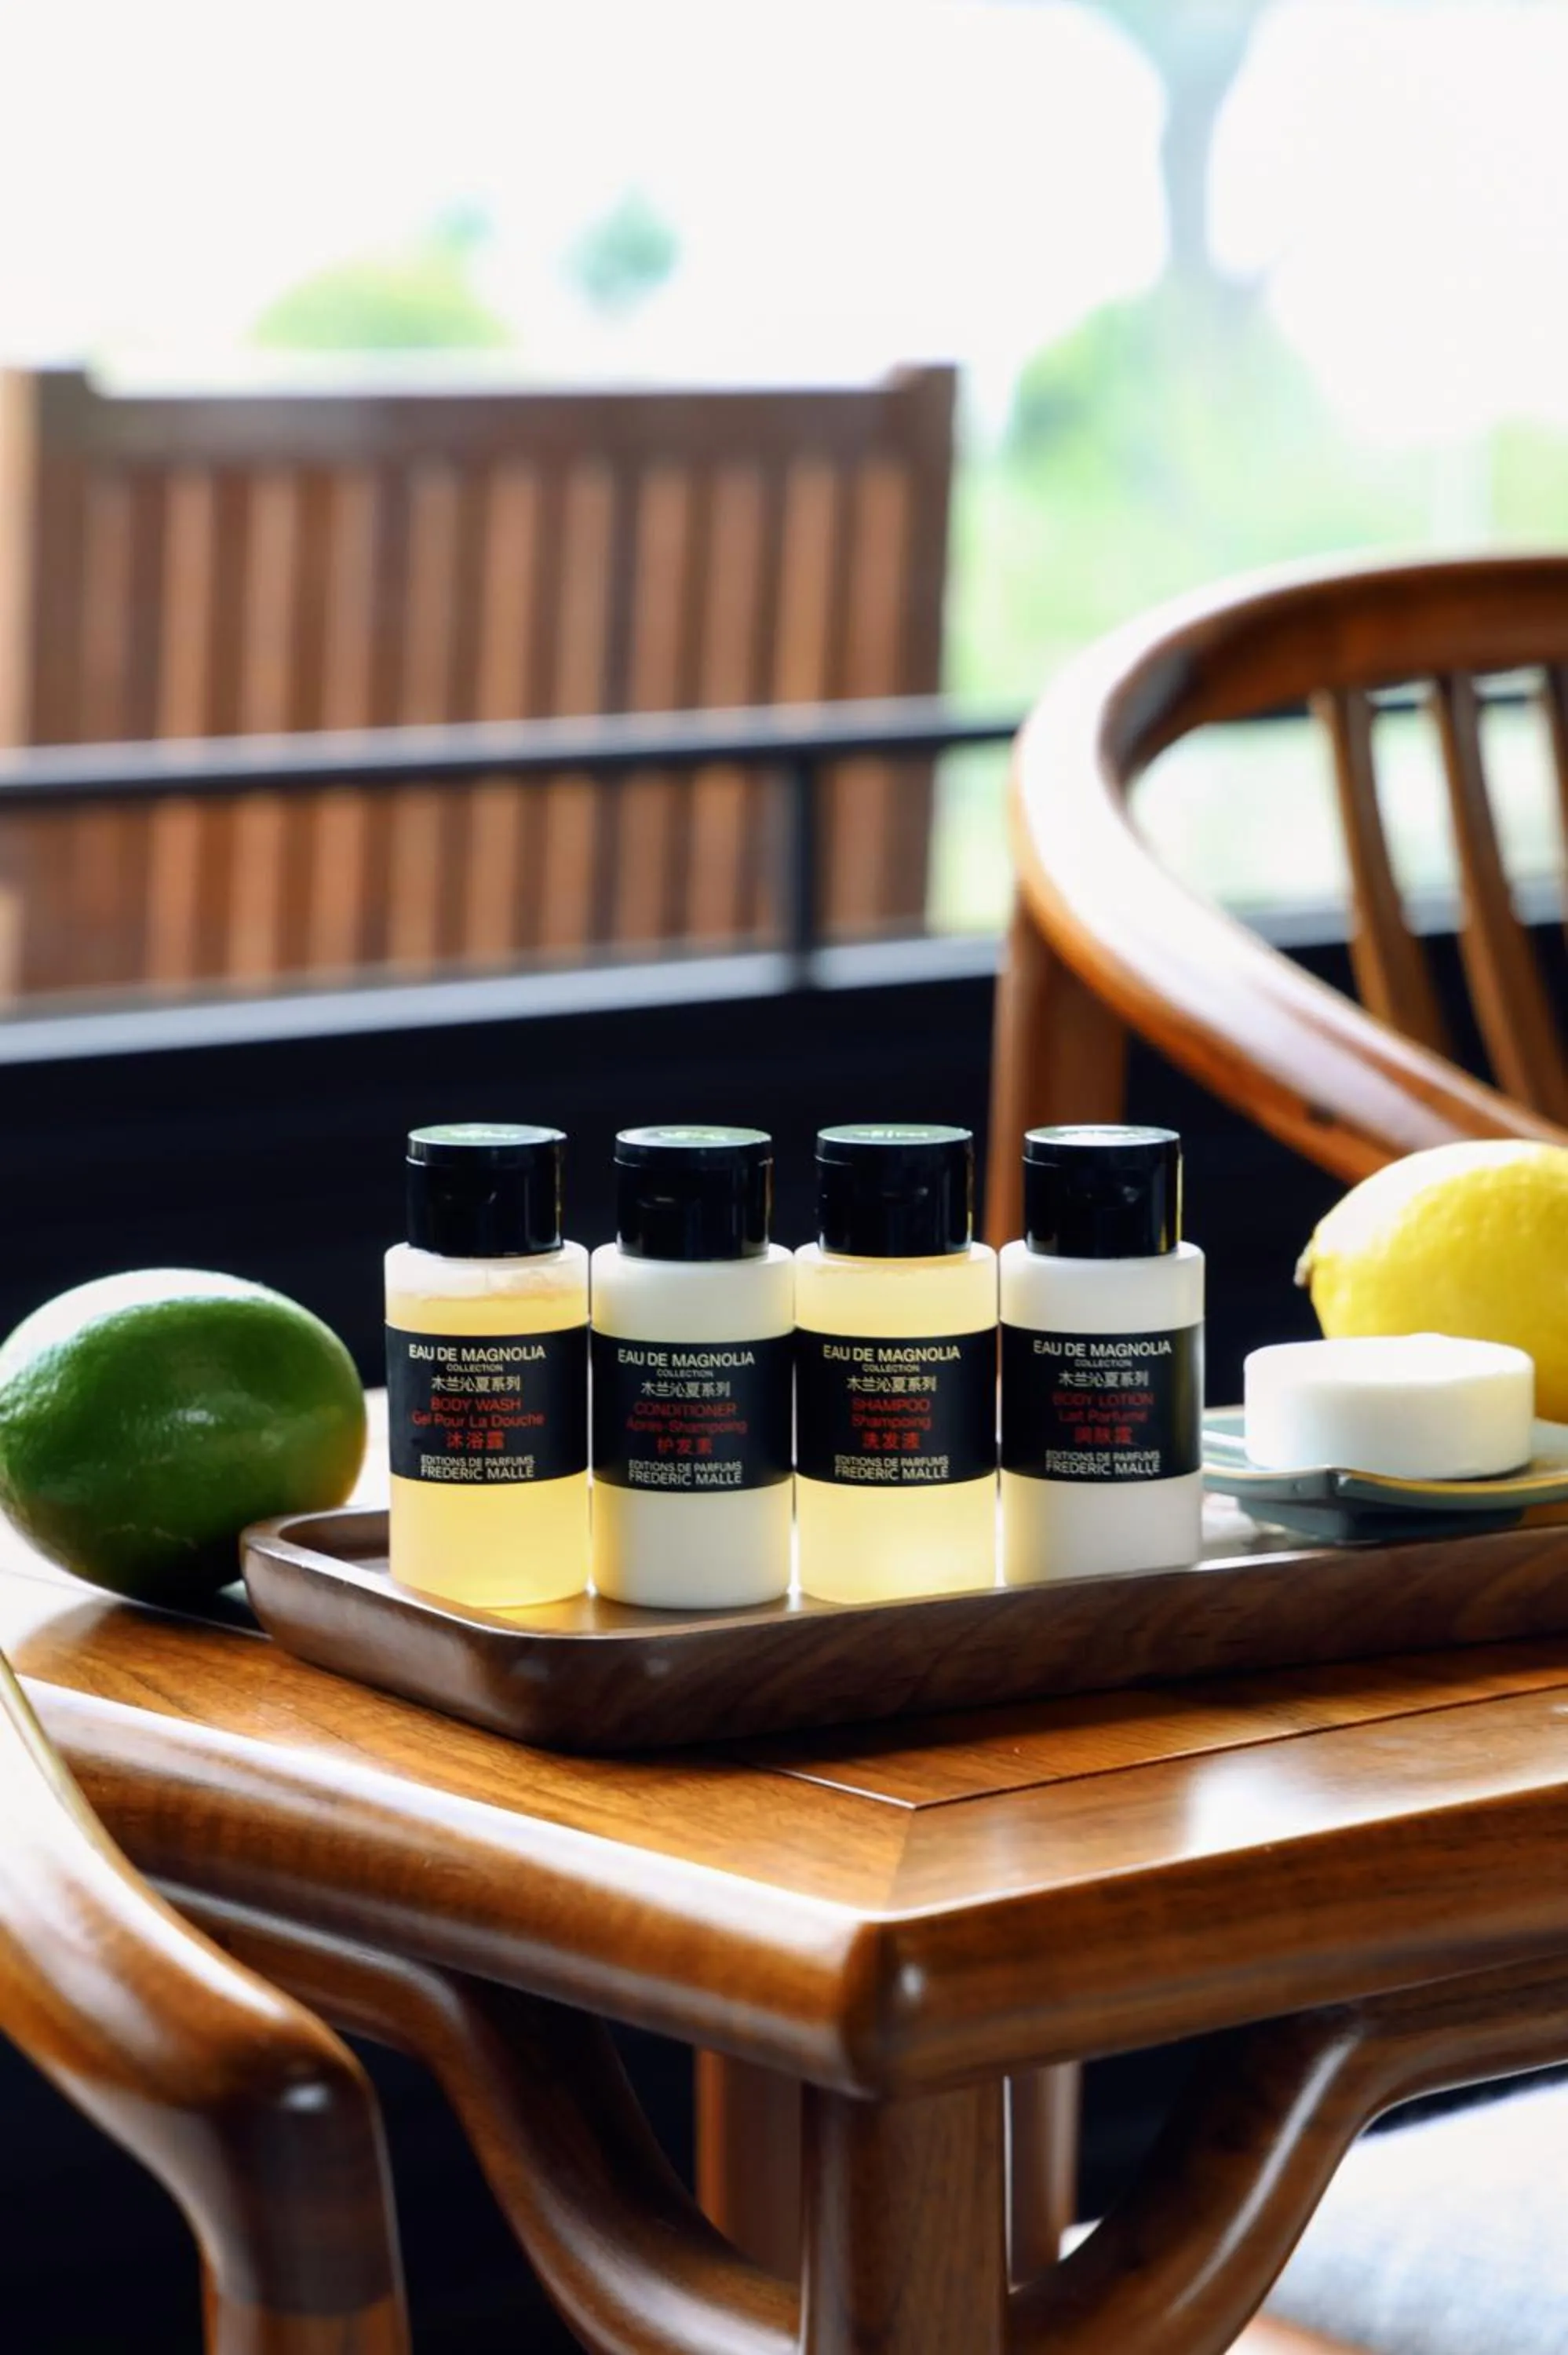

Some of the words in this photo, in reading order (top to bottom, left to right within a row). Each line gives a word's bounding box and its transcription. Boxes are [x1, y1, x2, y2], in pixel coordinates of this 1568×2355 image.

[409, 1344, 435, 1360] EAU
[437, 1348, 457, 1361] DE
[461, 1345, 545, 1361] MAGNOLIA
[823, 1345, 850, 1360] EAU
[853, 1348, 874, 1361] DE
[877, 1346, 961, 1362] MAGNOLIA
[1034, 1340, 1061, 1354] EAU
[1065, 1343, 1085, 1357] DE
[1090, 1341, 1172, 1357] MAGNOLIA
[618, 1349, 644, 1365] EAU
[647, 1353, 668, 1367] DE
[671, 1352, 755, 1367] MAGNOLIA
[657, 1369, 713, 1378] COLLECTION
[862, 1364, 920, 1372] COLLECTION
[430, 1397, 471, 1411] BODY
[475, 1397, 521, 1411] WASH
[852, 1398, 930, 1411] SHAMPOO
[1099, 1393, 1154, 1406] LOTION
[634, 1402, 738, 1416] CONDITIONER
[421, 1455, 465, 1466] EDITIONS
[469, 1458, 482, 1466] DE
[485, 1455, 534, 1466] PARFUMS
[834, 1455, 881, 1467] EDITIONS
[884, 1458, 898, 1467] DE
[901, 1455, 949, 1467] PARFUMS
[1046, 1450, 1094, 1462] EDITIONS
[1096, 1452, 1110, 1462] DE
[629, 1459, 674, 1472] EDITIONS
[677, 1462, 690, 1472] DE
[694, 1461, 742, 1472] PARFUMS
[1046, 1461, 1110, 1474] FREDERIC
[1114, 1461, 1160, 1474] MALLE
[421, 1466, 483, 1479] FREDERIC
[487, 1466, 534, 1479] MALLE
[629, 1470, 691, 1484] FREDERIC
[695, 1471, 742, 1484] MALLE
[834, 1466, 898, 1480] FREDERIC
[903, 1466, 950, 1480] MALLE
